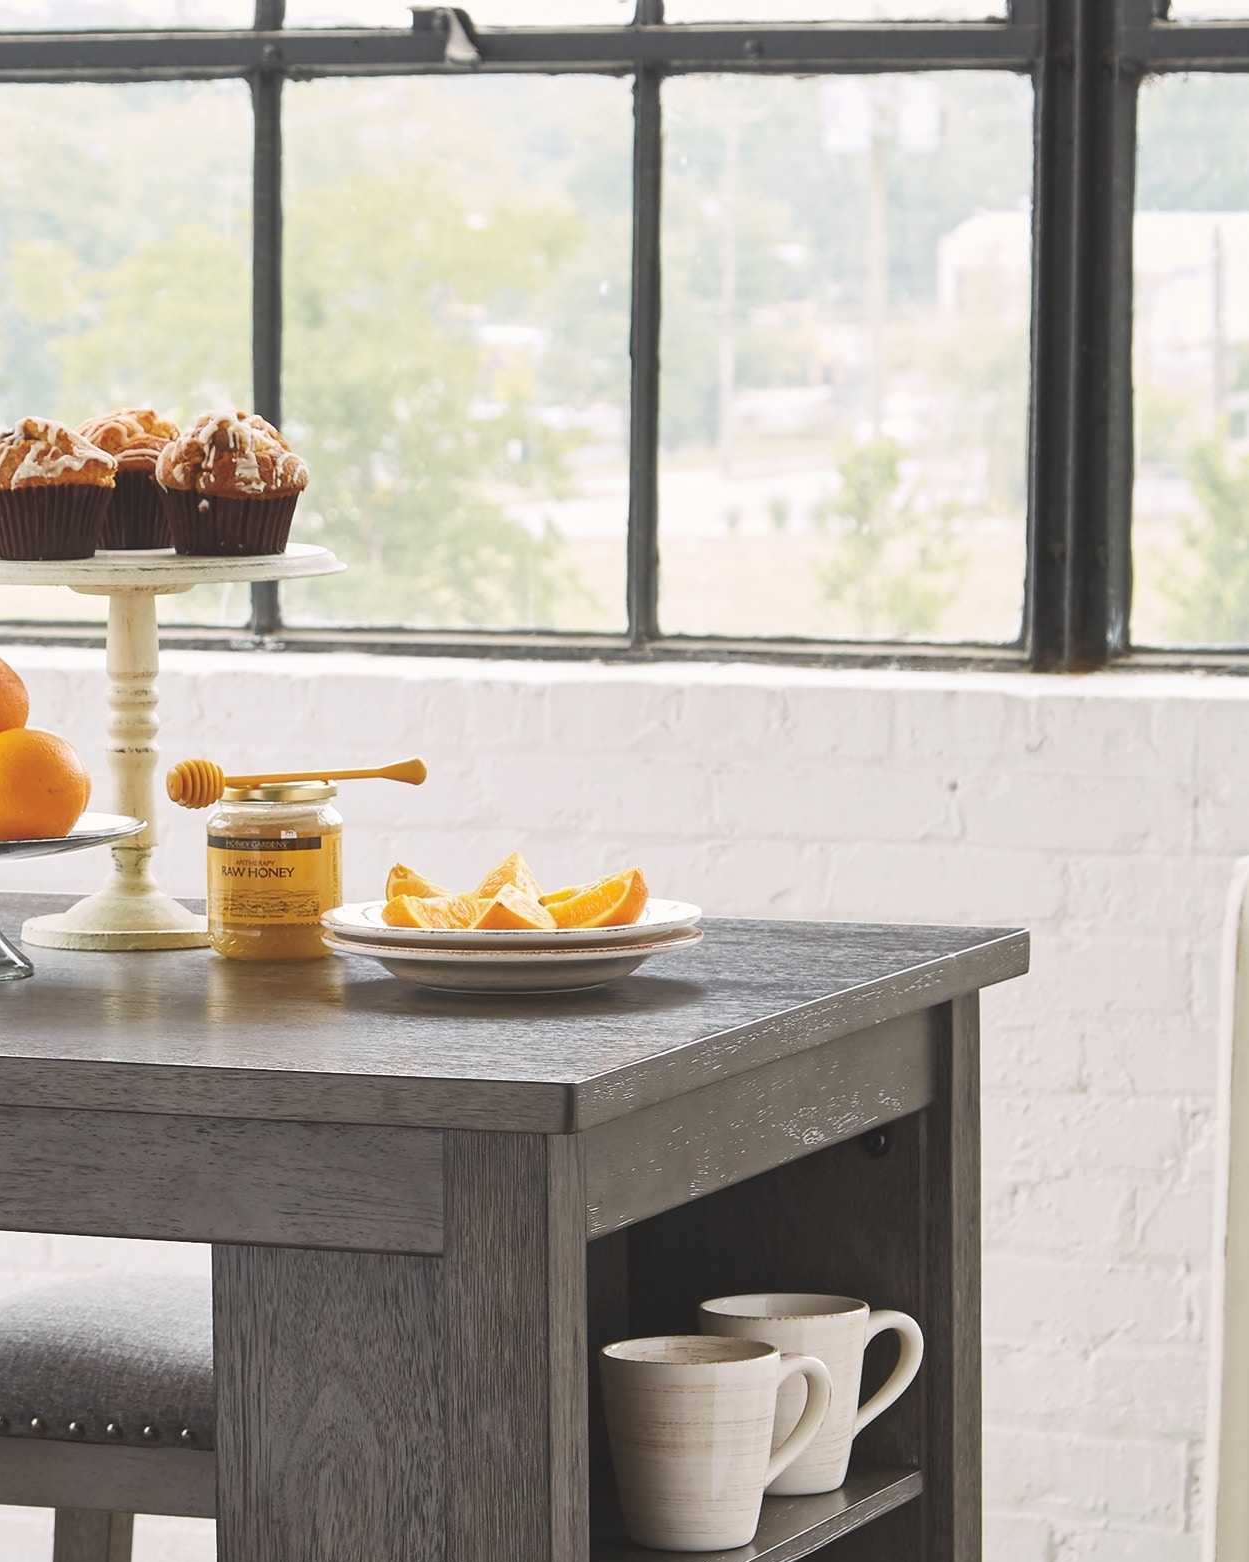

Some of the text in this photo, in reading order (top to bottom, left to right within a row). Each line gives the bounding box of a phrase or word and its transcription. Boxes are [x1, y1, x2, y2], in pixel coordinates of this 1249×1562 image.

[225, 840, 287, 849] HONEY GARDENS
[221, 865, 295, 878] RAW HONEY
